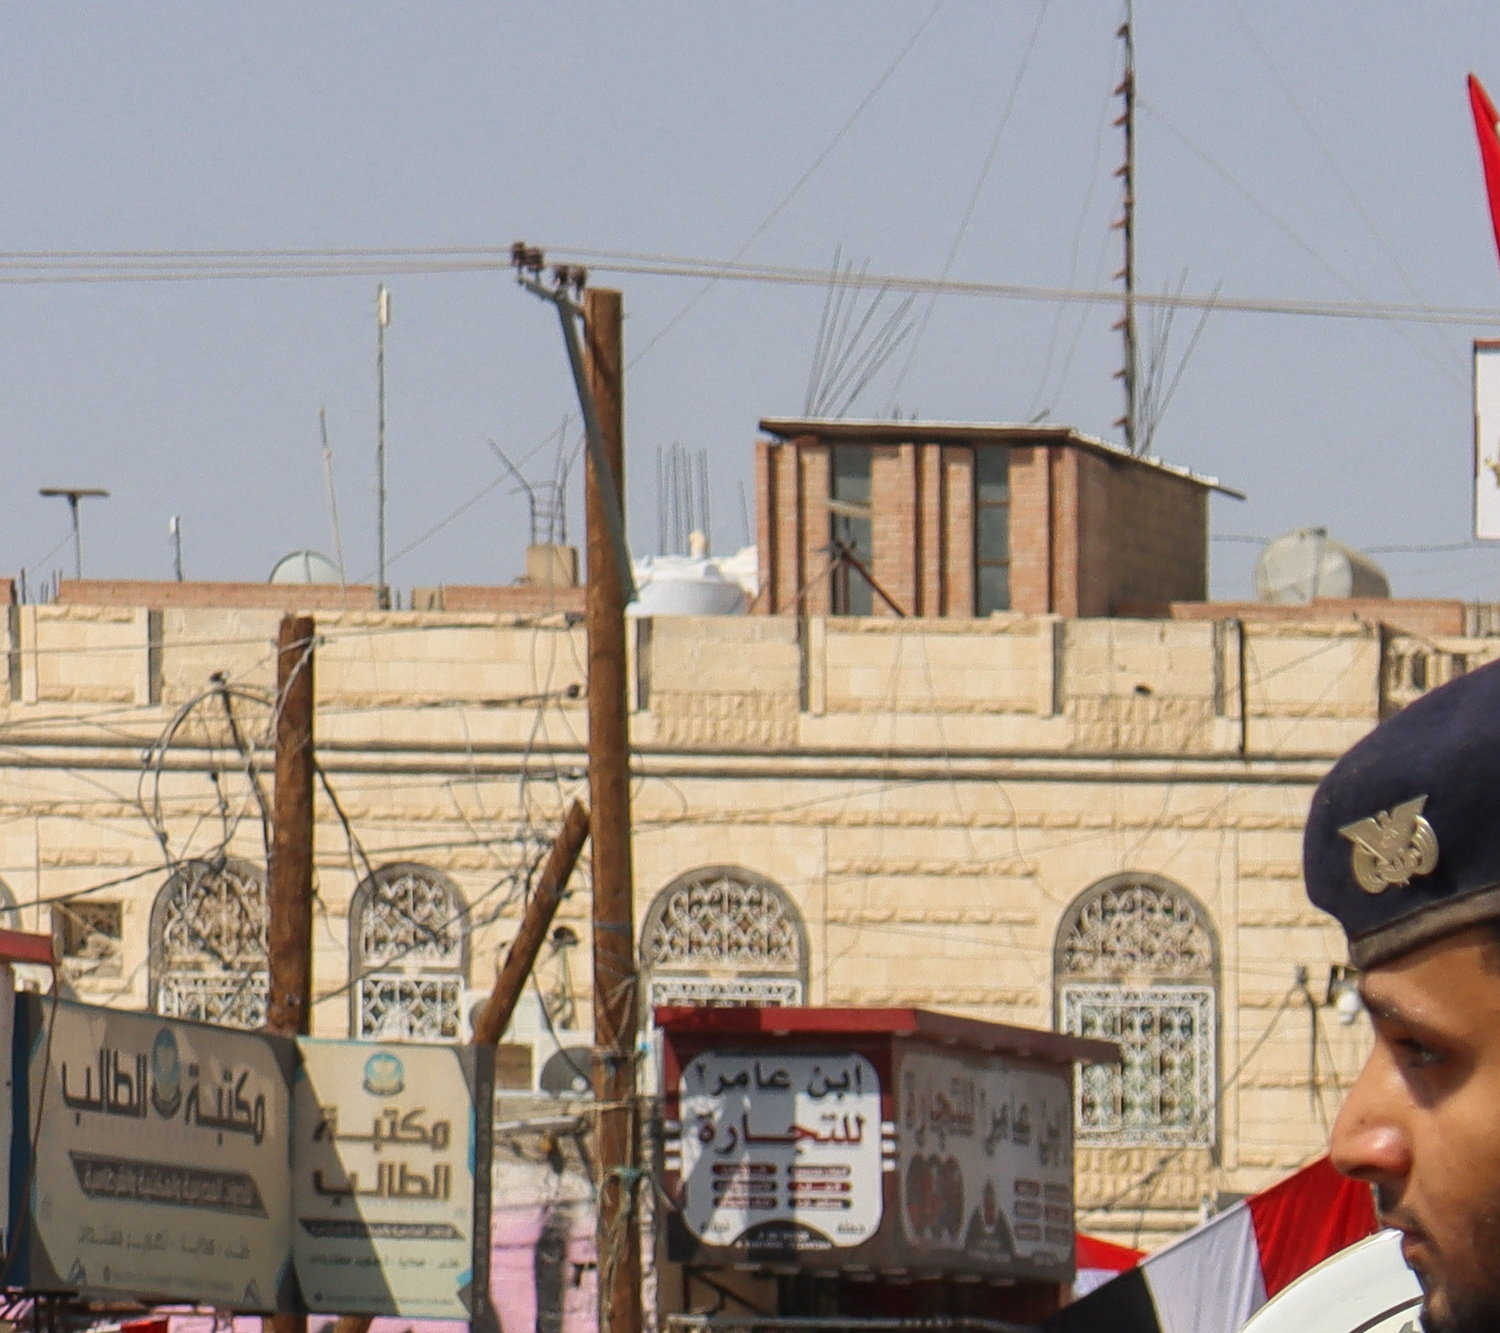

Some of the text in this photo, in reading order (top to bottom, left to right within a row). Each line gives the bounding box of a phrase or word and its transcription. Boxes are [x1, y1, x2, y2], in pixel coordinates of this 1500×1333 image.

[62, 1047, 266, 1146] مكتبة الطالب
[807, 1060, 865, 1098] ابن
[314, 1104, 451, 1152] مكتبة
[698, 1112, 867, 1155] للتجارة
[313, 1161, 451, 1206] الطالب
